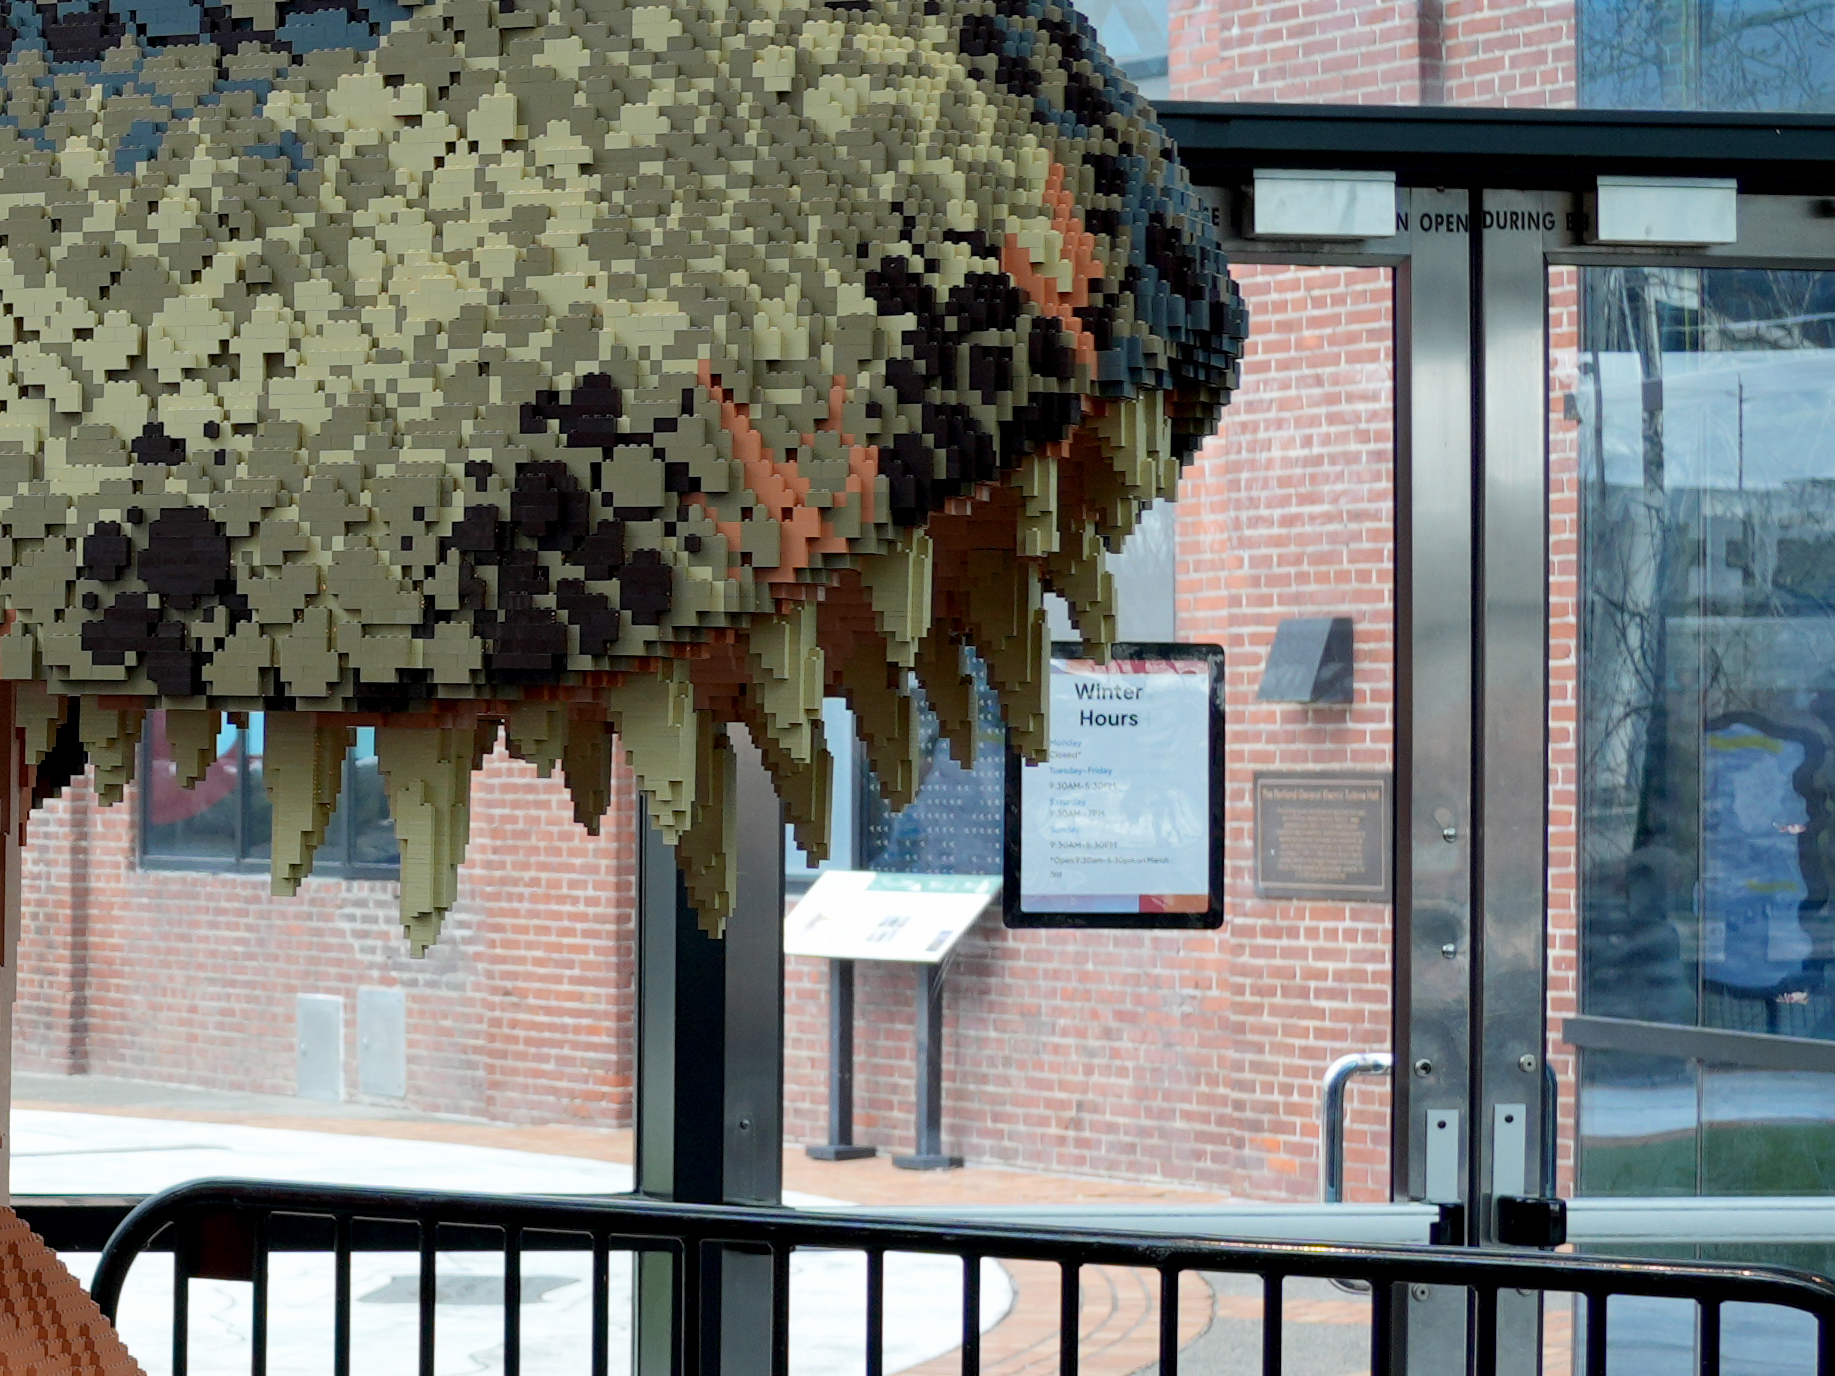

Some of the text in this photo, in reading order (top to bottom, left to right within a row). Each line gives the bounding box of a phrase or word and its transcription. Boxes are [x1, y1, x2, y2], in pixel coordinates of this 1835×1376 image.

[1419, 212, 1469, 233] OPEN
[1482, 210, 1556, 231] DURING
[1074, 682, 1143, 700] Winter
[1079, 709, 1139, 726] Hours
[1050, 738, 1082, 748] Monday
[1049, 797, 1086, 807] Saturday
[1049, 871, 1063, 879] 3rd
